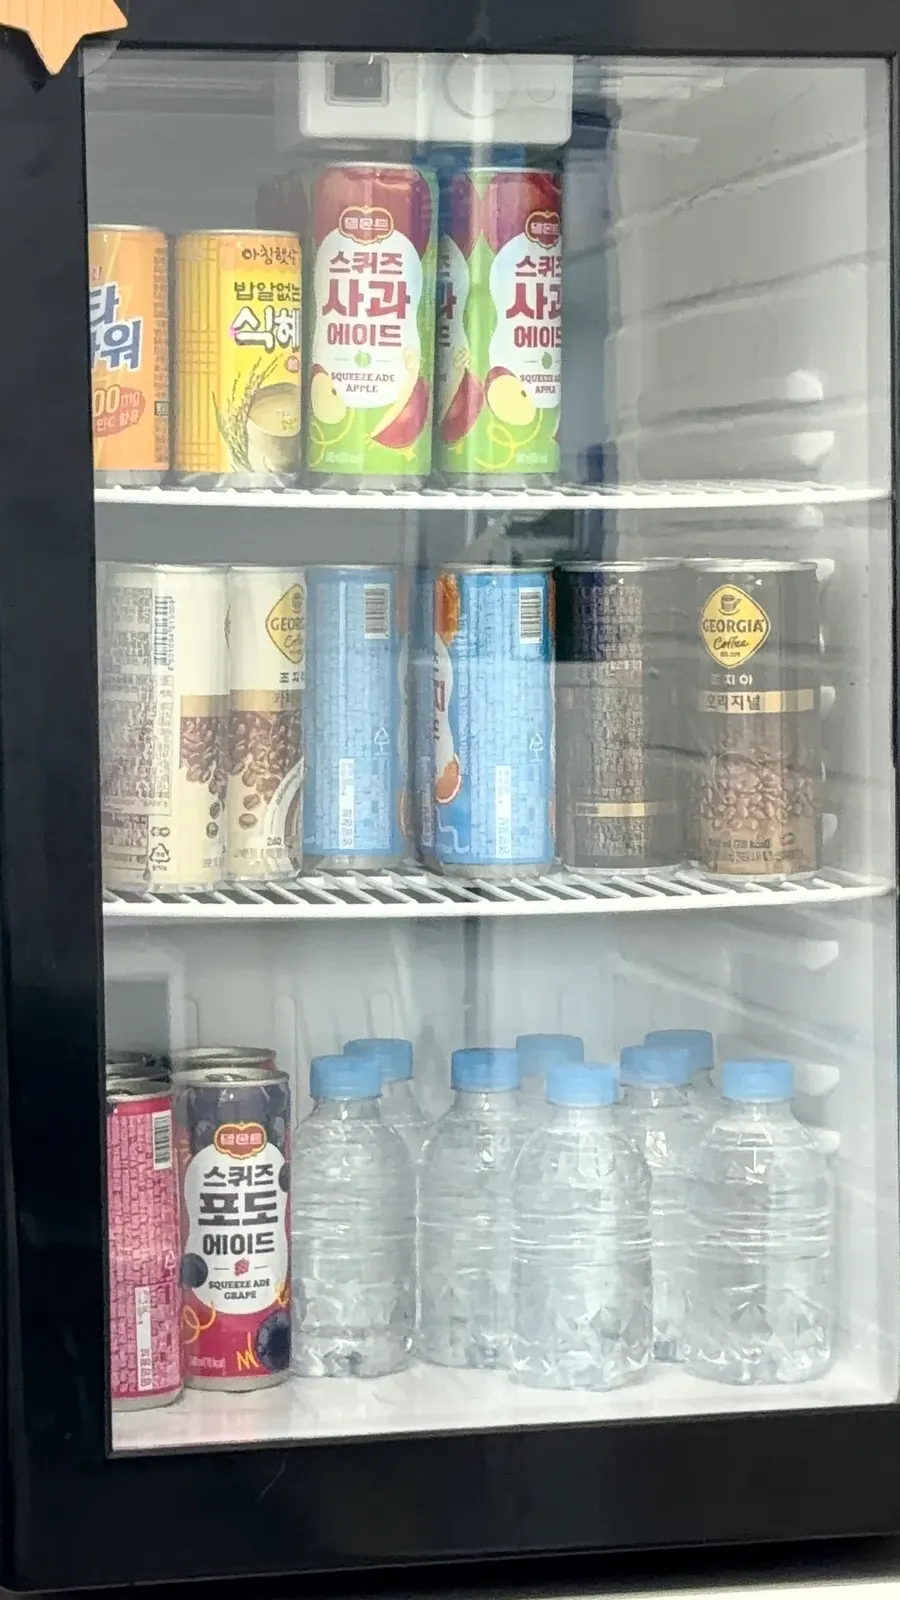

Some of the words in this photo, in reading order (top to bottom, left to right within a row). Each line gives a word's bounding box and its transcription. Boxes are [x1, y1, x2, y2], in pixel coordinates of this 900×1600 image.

[329, 251, 404, 275] 스퀴즈
[515, 254, 562, 278] 스퀴
[321, 279, 411, 319] 사과
[327, 323, 402, 347] 에이드
[331, 372, 374, 382] SQUEEZE
[345, 384, 378, 393] APPLE
[702, 618, 765, 633] GEORGIA
[713, 636, 750, 650] Coffee
[705, 693, 761, 711] 오리지널
[203, 1163, 274, 1187] 스퀴즈
[198, 1190, 278, 1226] 포도
[202, 1231, 275, 1256] 에이드
[208, 1280, 252, 1290] SQUEEZE
[253, 1278, 271, 1288] ADE
[223, 1290, 257, 1300] GRAPE
